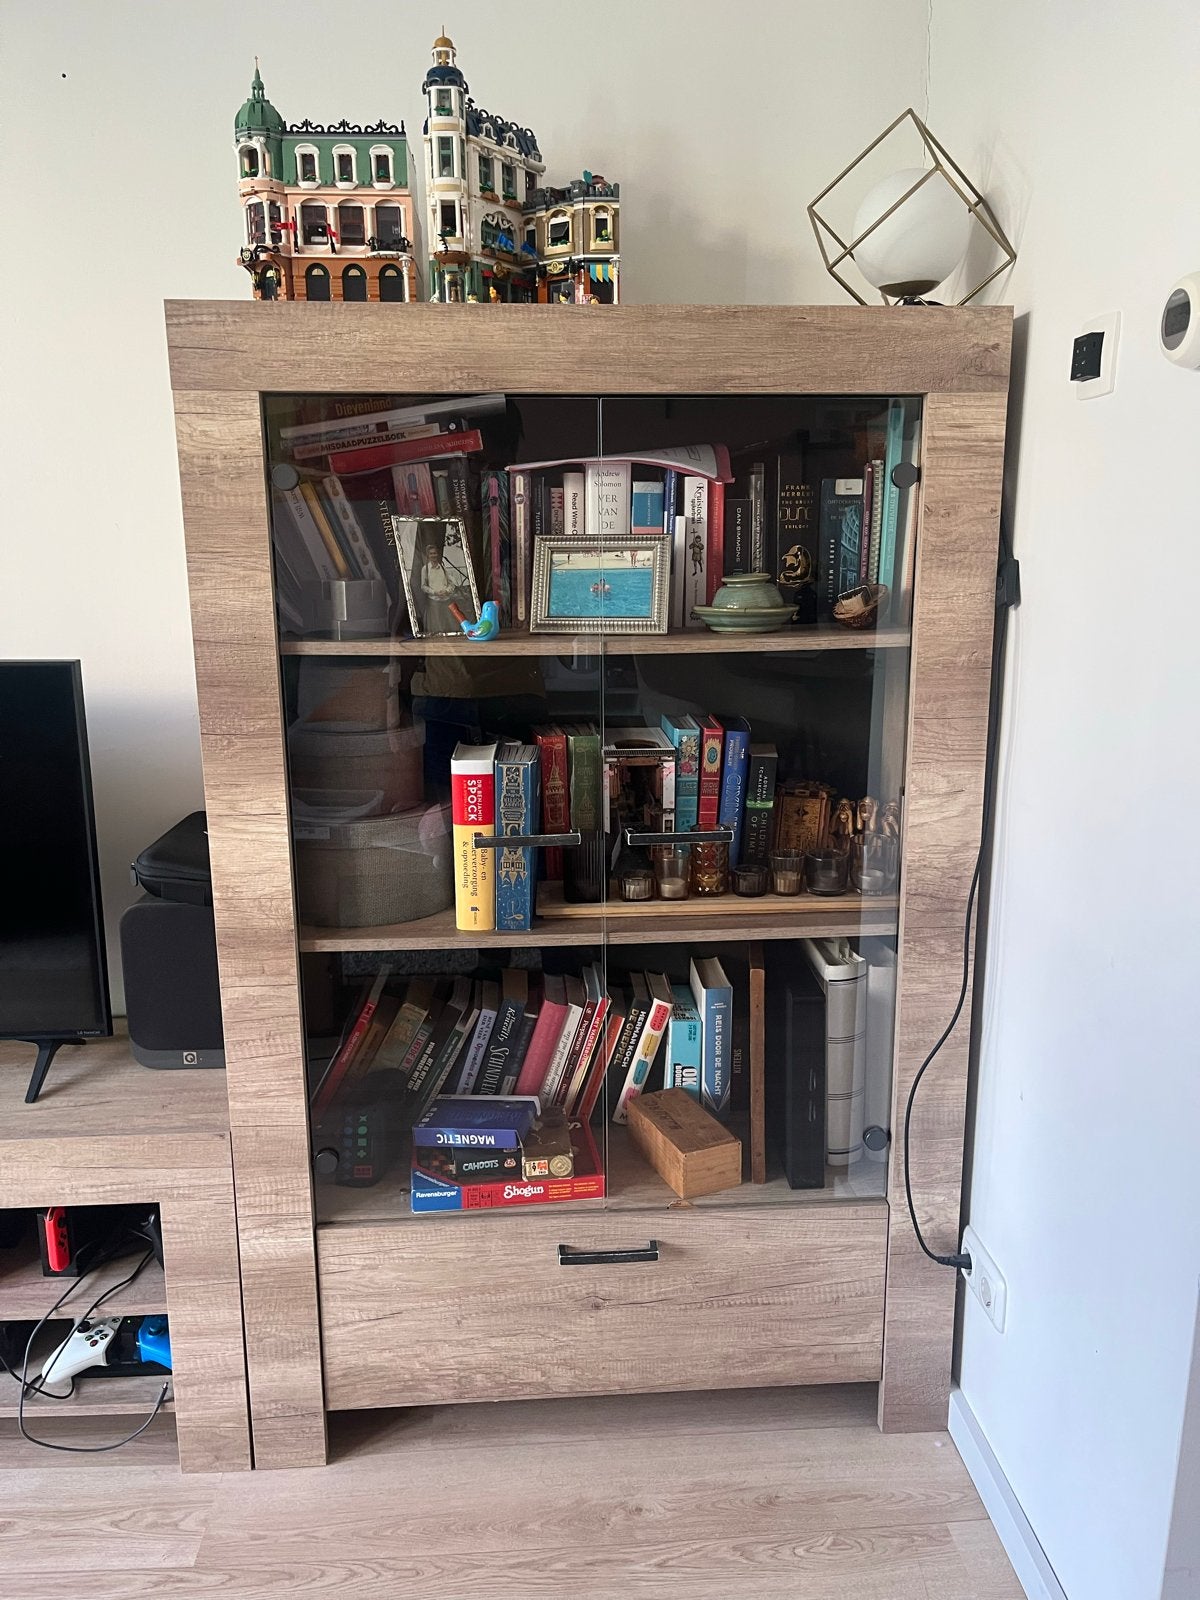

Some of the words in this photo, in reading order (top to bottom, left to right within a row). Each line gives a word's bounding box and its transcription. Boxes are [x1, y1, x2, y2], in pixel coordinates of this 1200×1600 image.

[335, 398, 393, 416] Dievenland
[694, 482, 705, 524] Kruistocht
[379, 499, 395, 547] STERREN
[467, 779, 477, 821] SPOCK
[748, 832, 757, 855] TIME
[758, 812, 768, 858] CHILDREN
[461, 850, 470, 889] opvoeding
[479, 848, 487, 869] Baby-
[496, 1006, 515, 1042] Keneally
[628, 1009, 639, 1023] DE
[629, 1010, 646, 1045] HERMAN
[614, 1023, 634, 1066] GREPPEL
[714, 1035, 722, 1055] DOOR
[621, 1045, 634, 1068] KOCH
[715, 1058, 722, 1067] DE
[674, 1065, 683, 1087] BOOME
[681, 1068, 698, 1086] OK
[714, 1070, 722, 1096] NACHT
[436, 1133, 495, 1146] MAGNETIC
[415, 1190, 458, 1199] Ravensburger
[503, 1185, 544, 1199] Shogun
